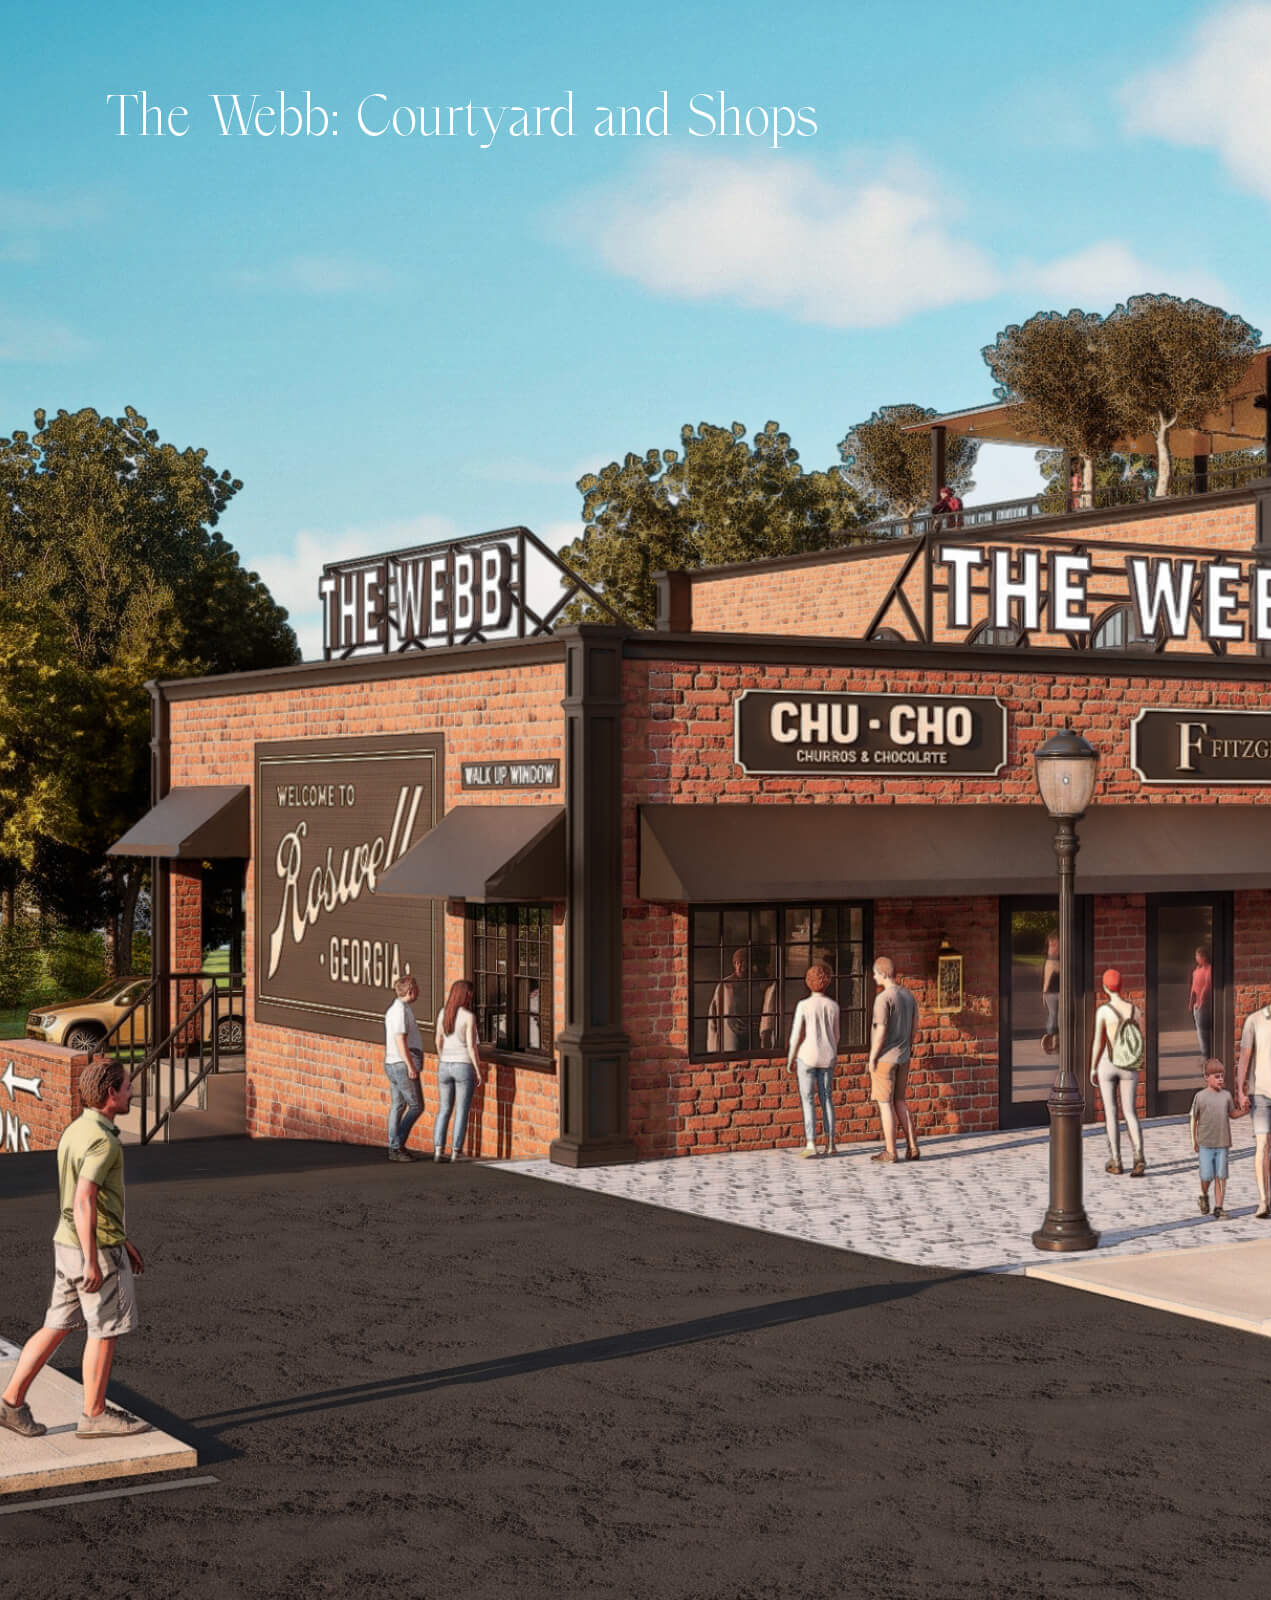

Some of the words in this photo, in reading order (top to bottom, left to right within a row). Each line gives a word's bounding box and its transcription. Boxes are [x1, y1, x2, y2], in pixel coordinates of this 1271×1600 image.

[321, 569, 379, 649] THE
[397, 547, 503, 641] WEBB
[938, 547, 1092, 633] THE
[770, 701, 859, 744] CHU
[889, 704, 973, 746] CHO
[464, 765, 492, 785] WALK
[494, 765, 508, 785] UP
[510, 763, 556, 785] WINDOW
[796, 749, 857, 764] CHURROS
[860, 750, 870, 763] &
[874, 750, 948, 765] CHOCOLATE
[277, 785, 335, 807] WELCOME
[339, 785, 355, 806] TO
[267, 785, 424, 981] Roswell
[329, 935, 400, 990] GEORGIA
